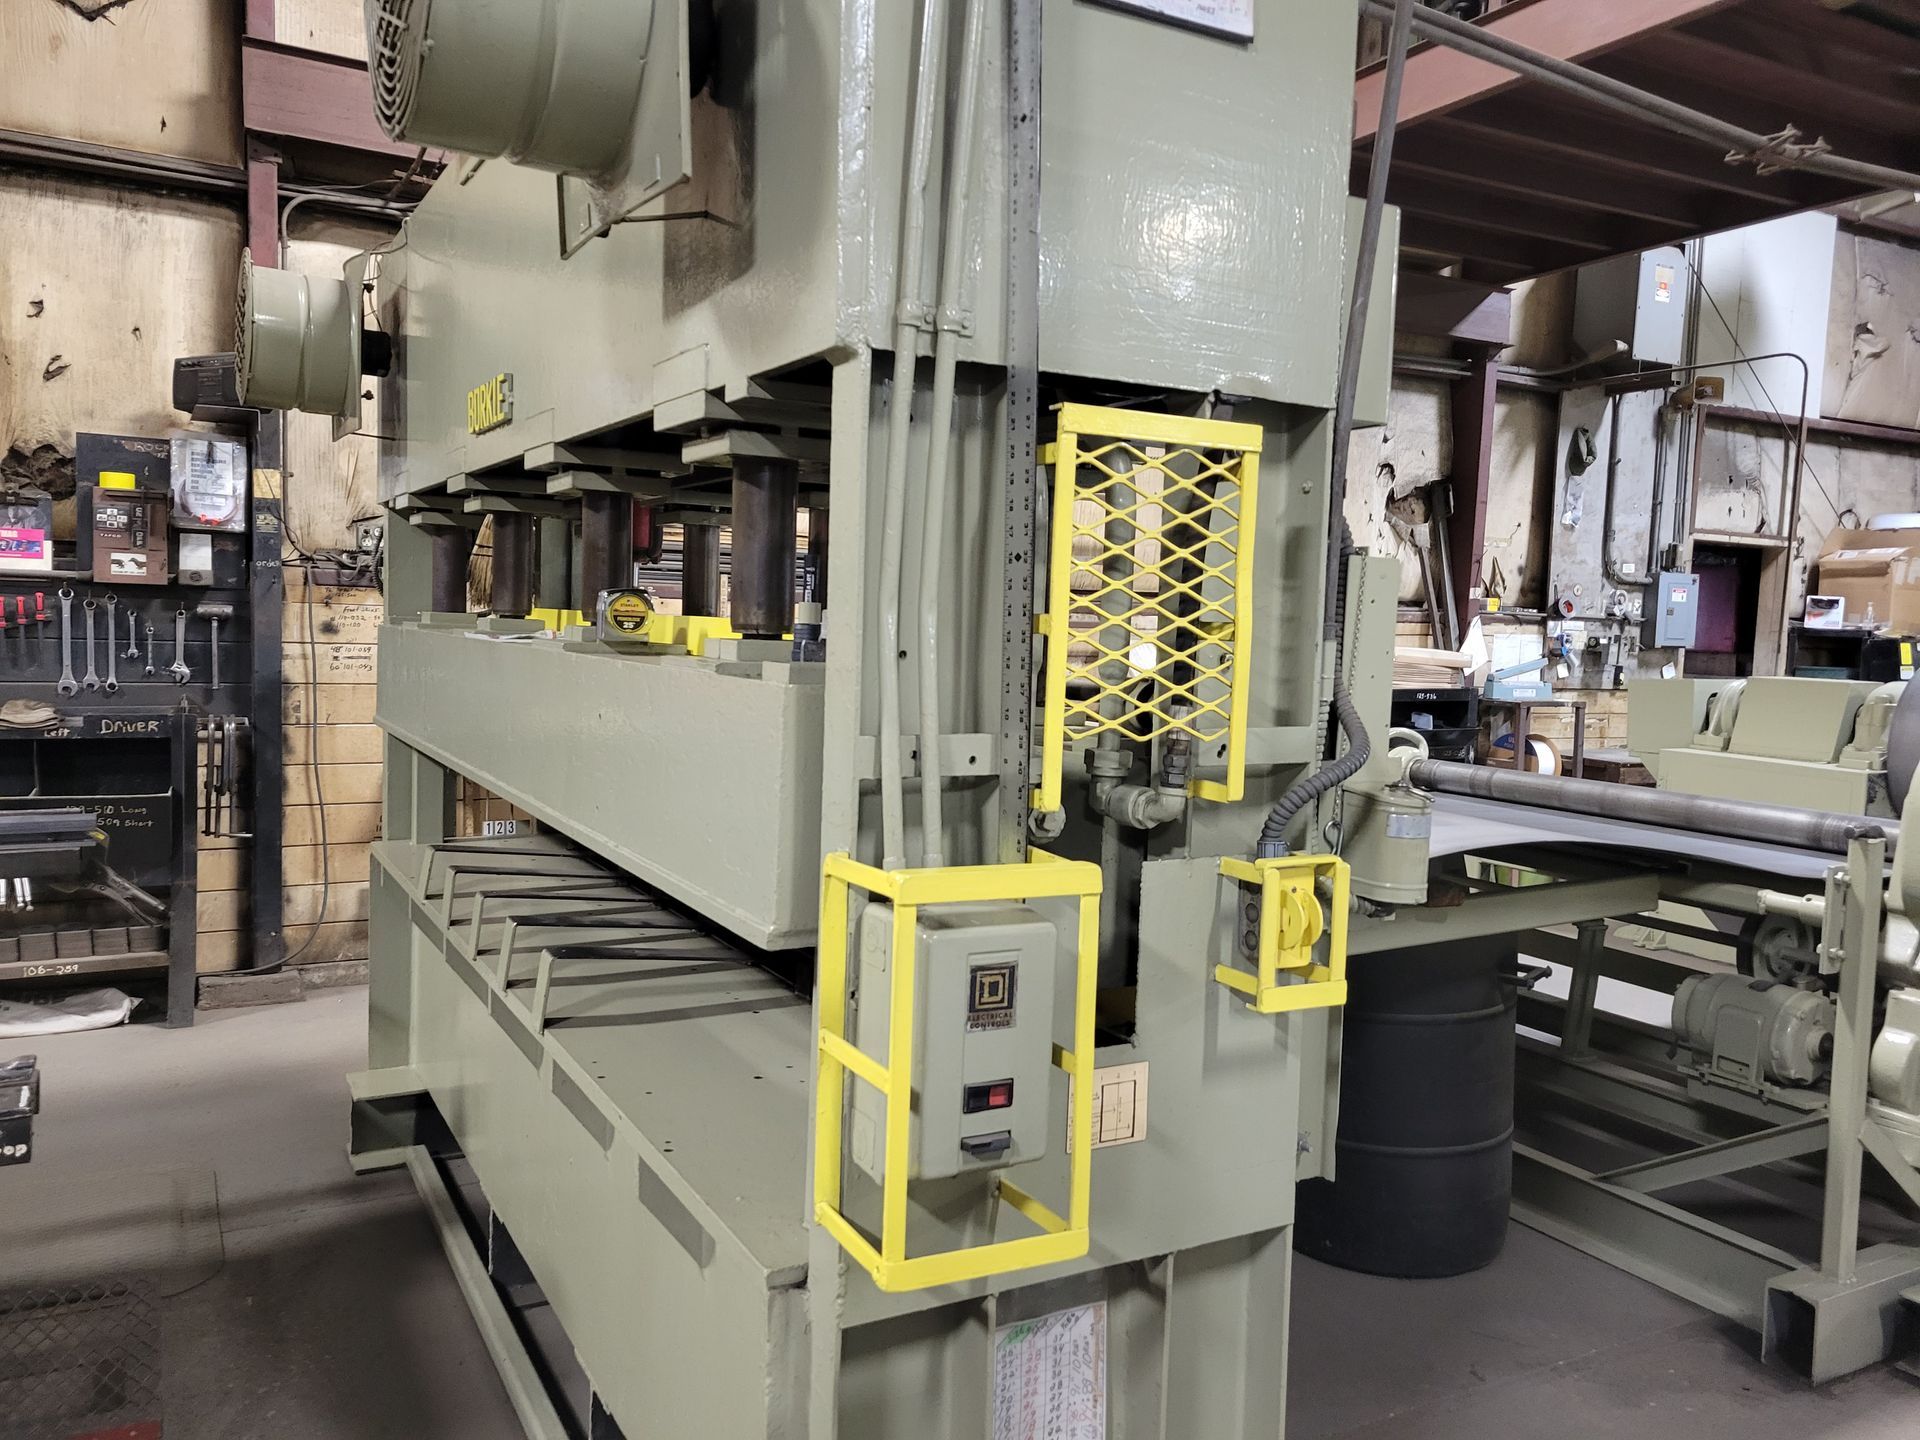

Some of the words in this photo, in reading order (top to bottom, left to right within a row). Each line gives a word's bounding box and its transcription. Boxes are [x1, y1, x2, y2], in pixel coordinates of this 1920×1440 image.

[1024, 496, 1029, 511] 30
[1009, 525, 1014, 538] 17
[1008, 578, 1013, 590] 15
[1007, 603, 1012, 617] 14
[1022, 603, 1027, 617] 34
[1006, 630, 1011, 643] 13
[1006, 656, 1010, 670] 12
[1005, 682, 1010, 694] 11
[1020, 682, 1025, 696] 37
[1004, 708, 1009, 720] 10
[1018, 760, 1023, 775] 40
[968, 1012, 1012, 1021] ELECTRICAL
[970, 1020, 1010, 1030] CONTROLS
